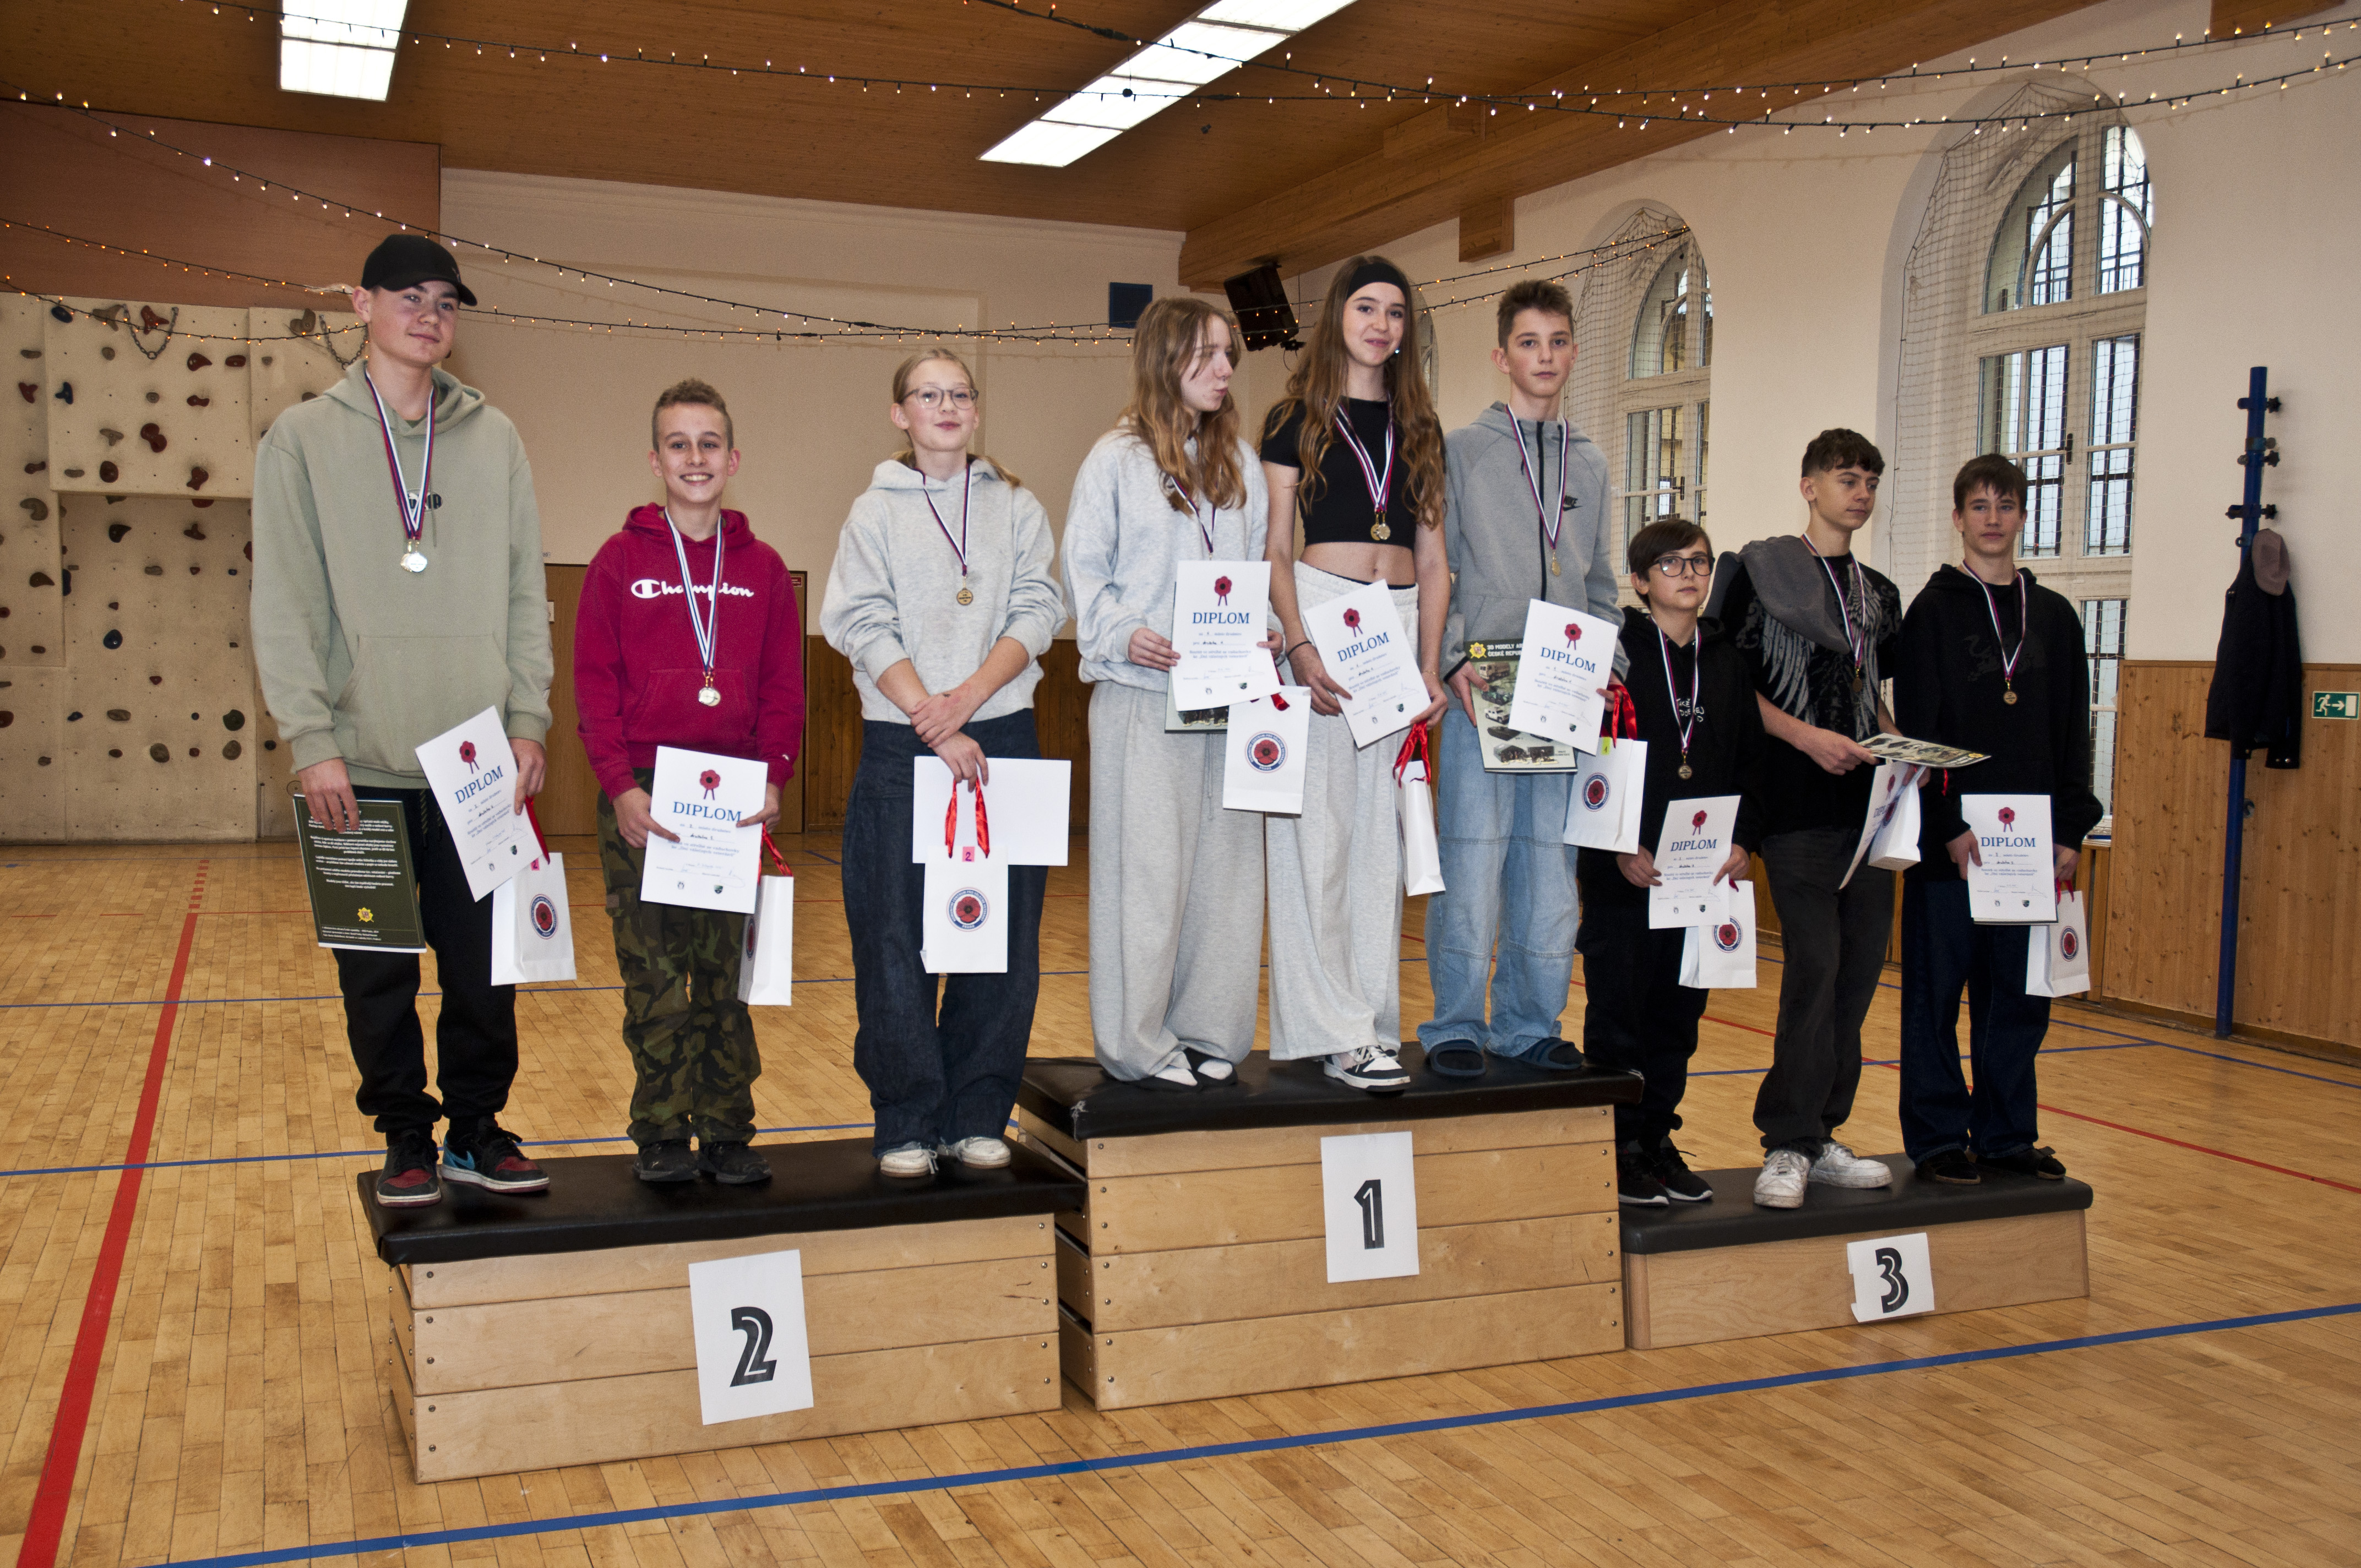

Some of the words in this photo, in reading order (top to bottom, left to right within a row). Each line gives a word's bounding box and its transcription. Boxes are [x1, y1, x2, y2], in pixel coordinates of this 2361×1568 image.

[1192, 612, 1250, 624] DIPLOM
[1337, 632, 1389, 662] DIPLOM
[1541, 646, 1596, 673] DIPLOM
[454, 765, 503, 804] DIPLOM
[673, 801, 742, 823] DIPLOM
[1671, 839, 1717, 852] DIPLOM
[1981, 837, 2036, 847] DIPLOM
[965, 852, 972, 862] 2
[1354, 1179, 1385, 1250] 1
[1875, 1247, 1909, 1314] 3
[730, 1306, 777, 1387] 2
